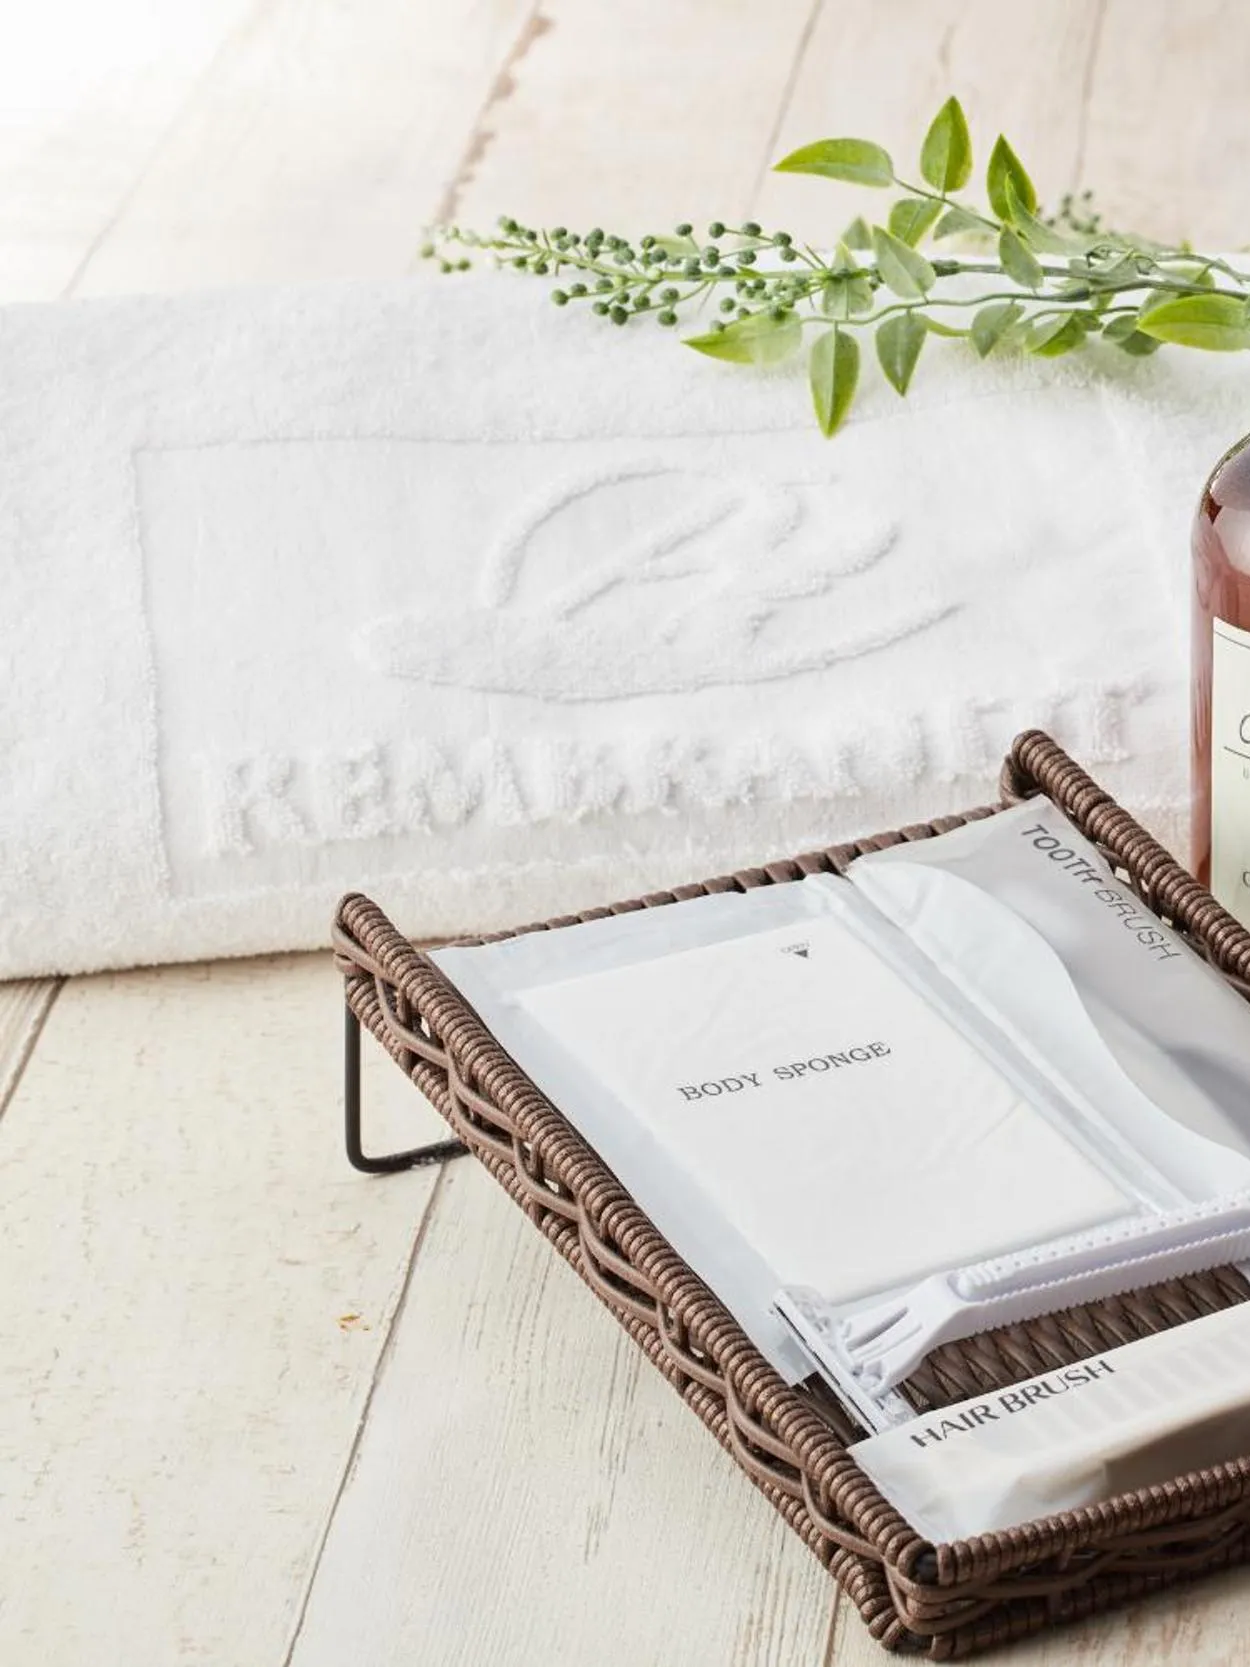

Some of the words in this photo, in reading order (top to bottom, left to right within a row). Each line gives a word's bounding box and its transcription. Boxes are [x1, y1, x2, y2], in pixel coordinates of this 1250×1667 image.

[1021, 824, 1104, 885] TOOTH
[1094, 889, 1182, 961] BRUSH
[677, 1072, 763, 1102] BODY
[772, 1040, 892, 1082] SPONGE
[910, 1402, 1000, 1449] HAIR
[997, 1358, 1117, 1414] BRUSH
